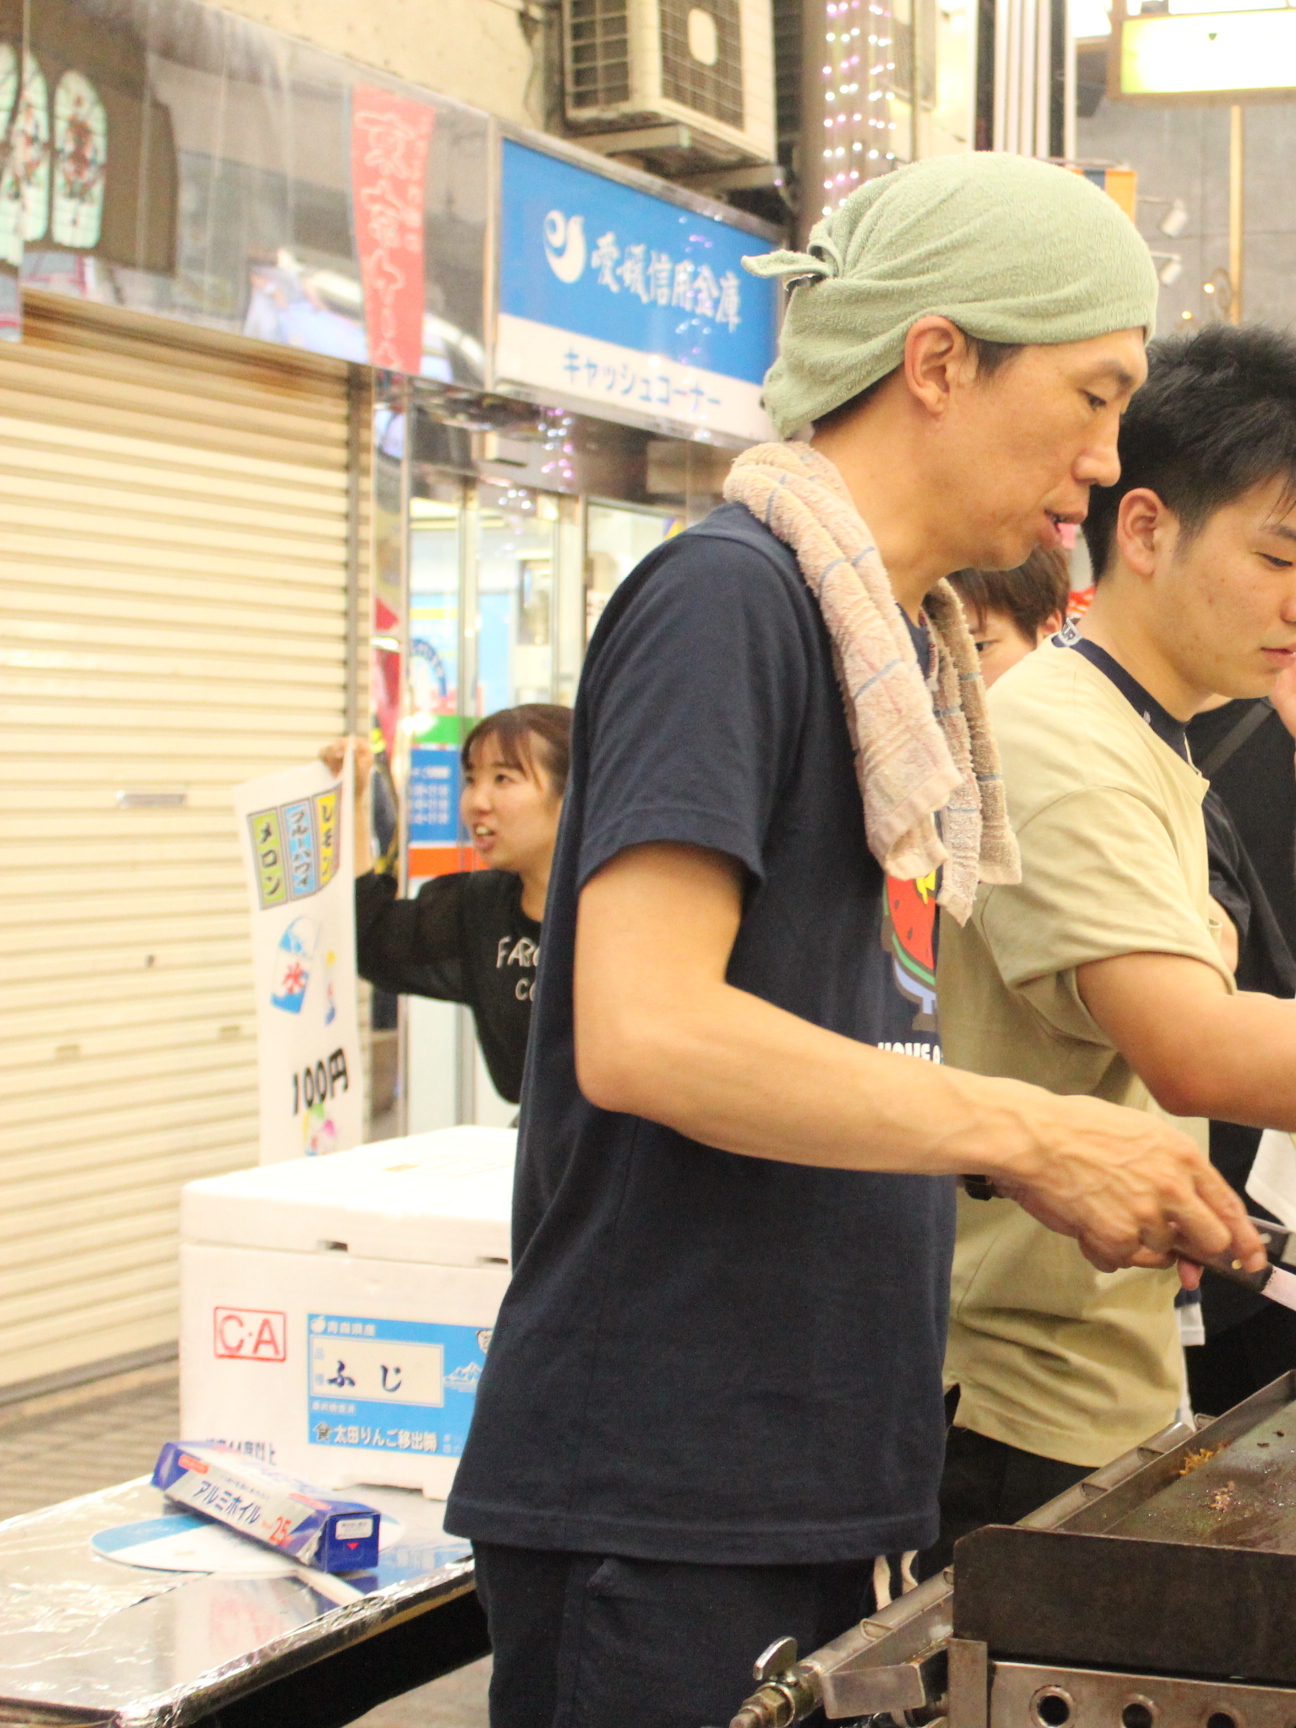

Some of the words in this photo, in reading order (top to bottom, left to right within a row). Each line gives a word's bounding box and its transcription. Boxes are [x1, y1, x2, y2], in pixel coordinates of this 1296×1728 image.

[562, 346, 721, 411] キャッシュコーナー
[259, 822, 281, 896] メロン
[293, 1048, 349, 1116] 100円
[193, 1479, 262, 1526] アルミホイル
